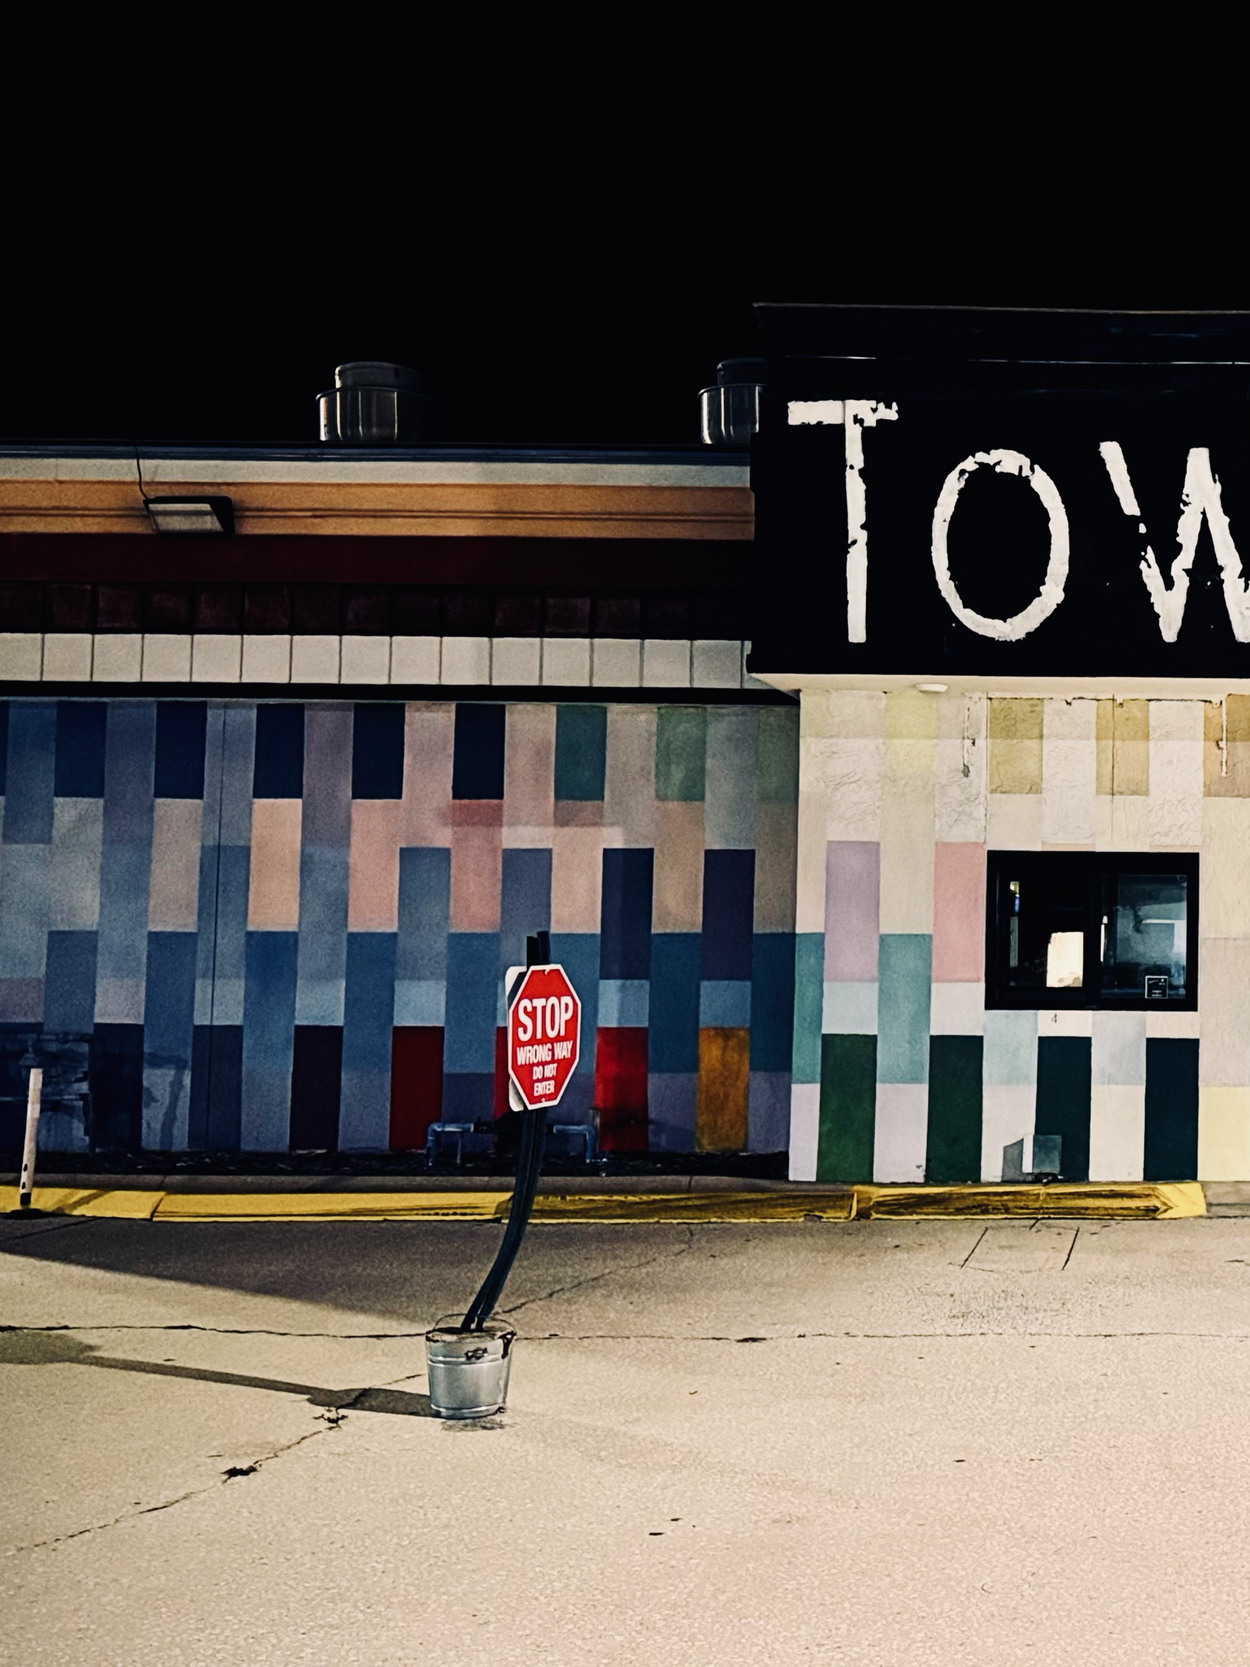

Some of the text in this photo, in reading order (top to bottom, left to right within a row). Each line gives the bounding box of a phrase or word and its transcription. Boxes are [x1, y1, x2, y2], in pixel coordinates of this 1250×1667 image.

[517, 996, 574, 1042] STOP
[516, 1040, 574, 1066] WRONG WAY
[532, 1063, 558, 1080] DO NOT
[533, 1081, 555, 1097] ENTER
